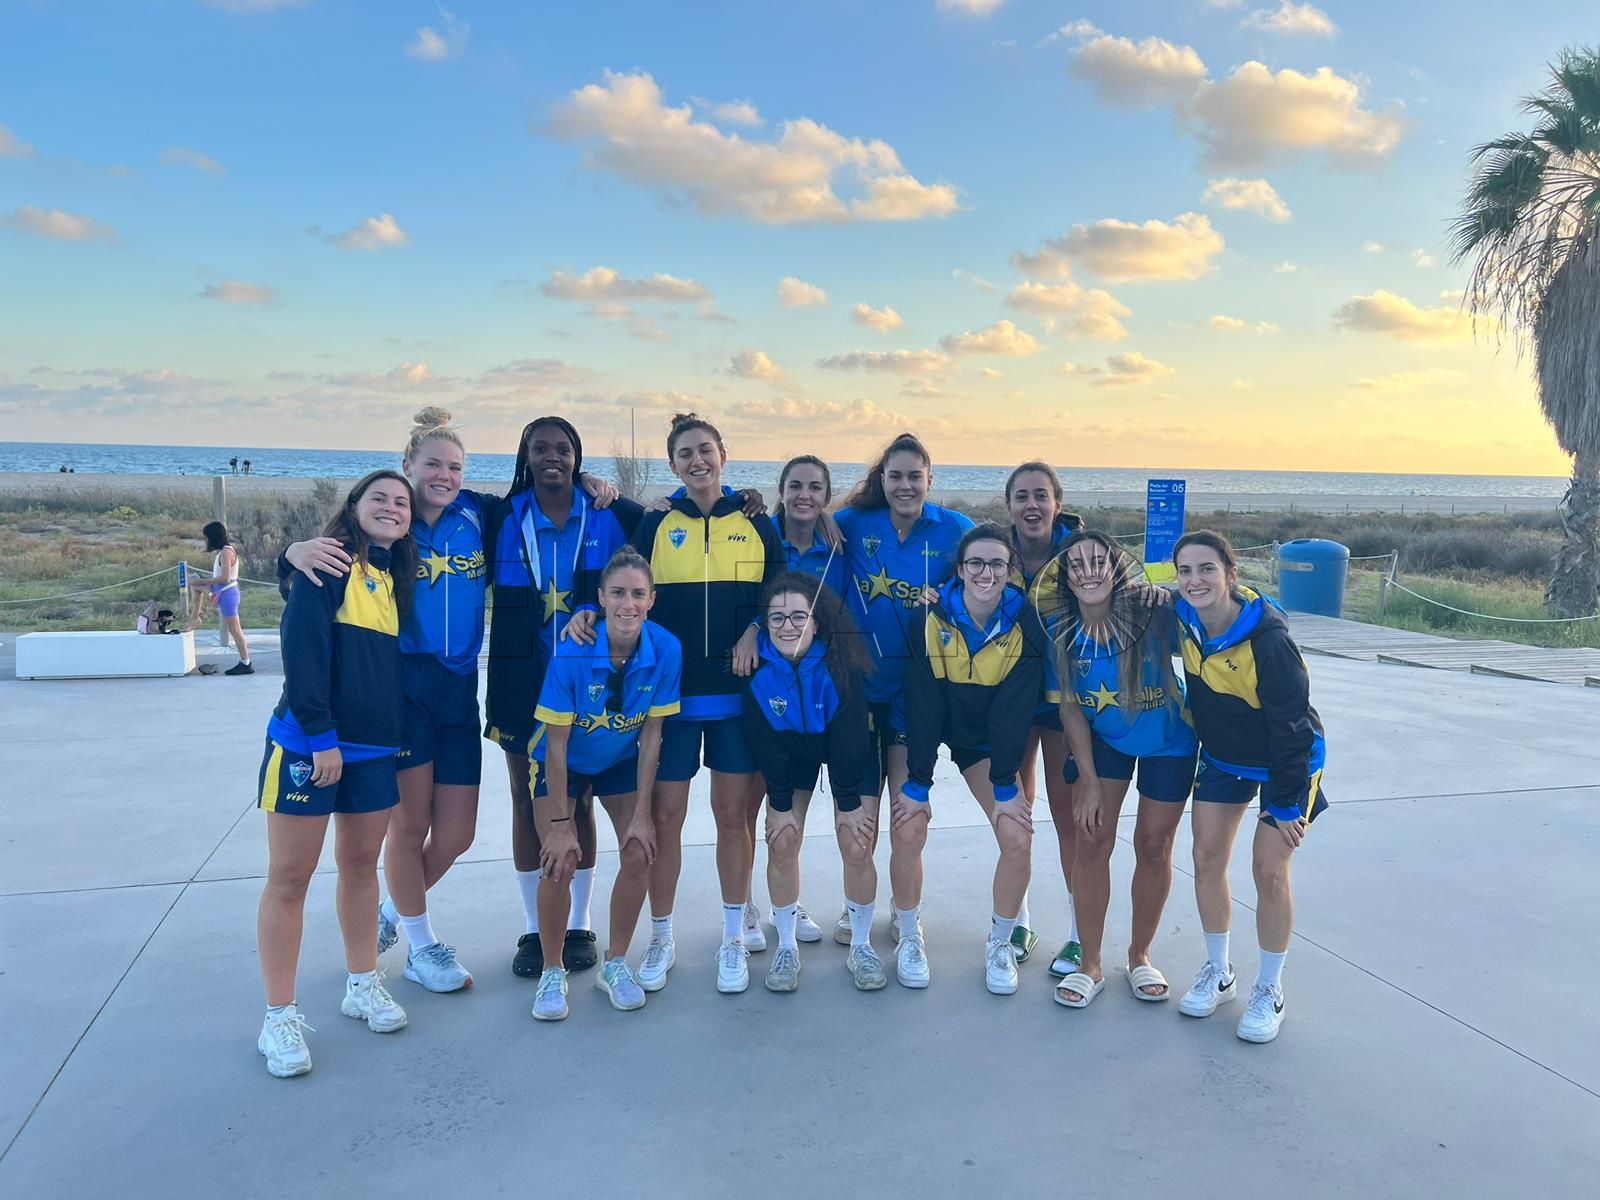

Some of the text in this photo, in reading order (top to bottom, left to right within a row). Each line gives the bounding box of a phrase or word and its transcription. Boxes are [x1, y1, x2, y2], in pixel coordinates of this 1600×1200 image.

[1172, 484, 1184, 493] 05
[727, 533, 747, 543] vive
[286, 791, 310, 803] vive
